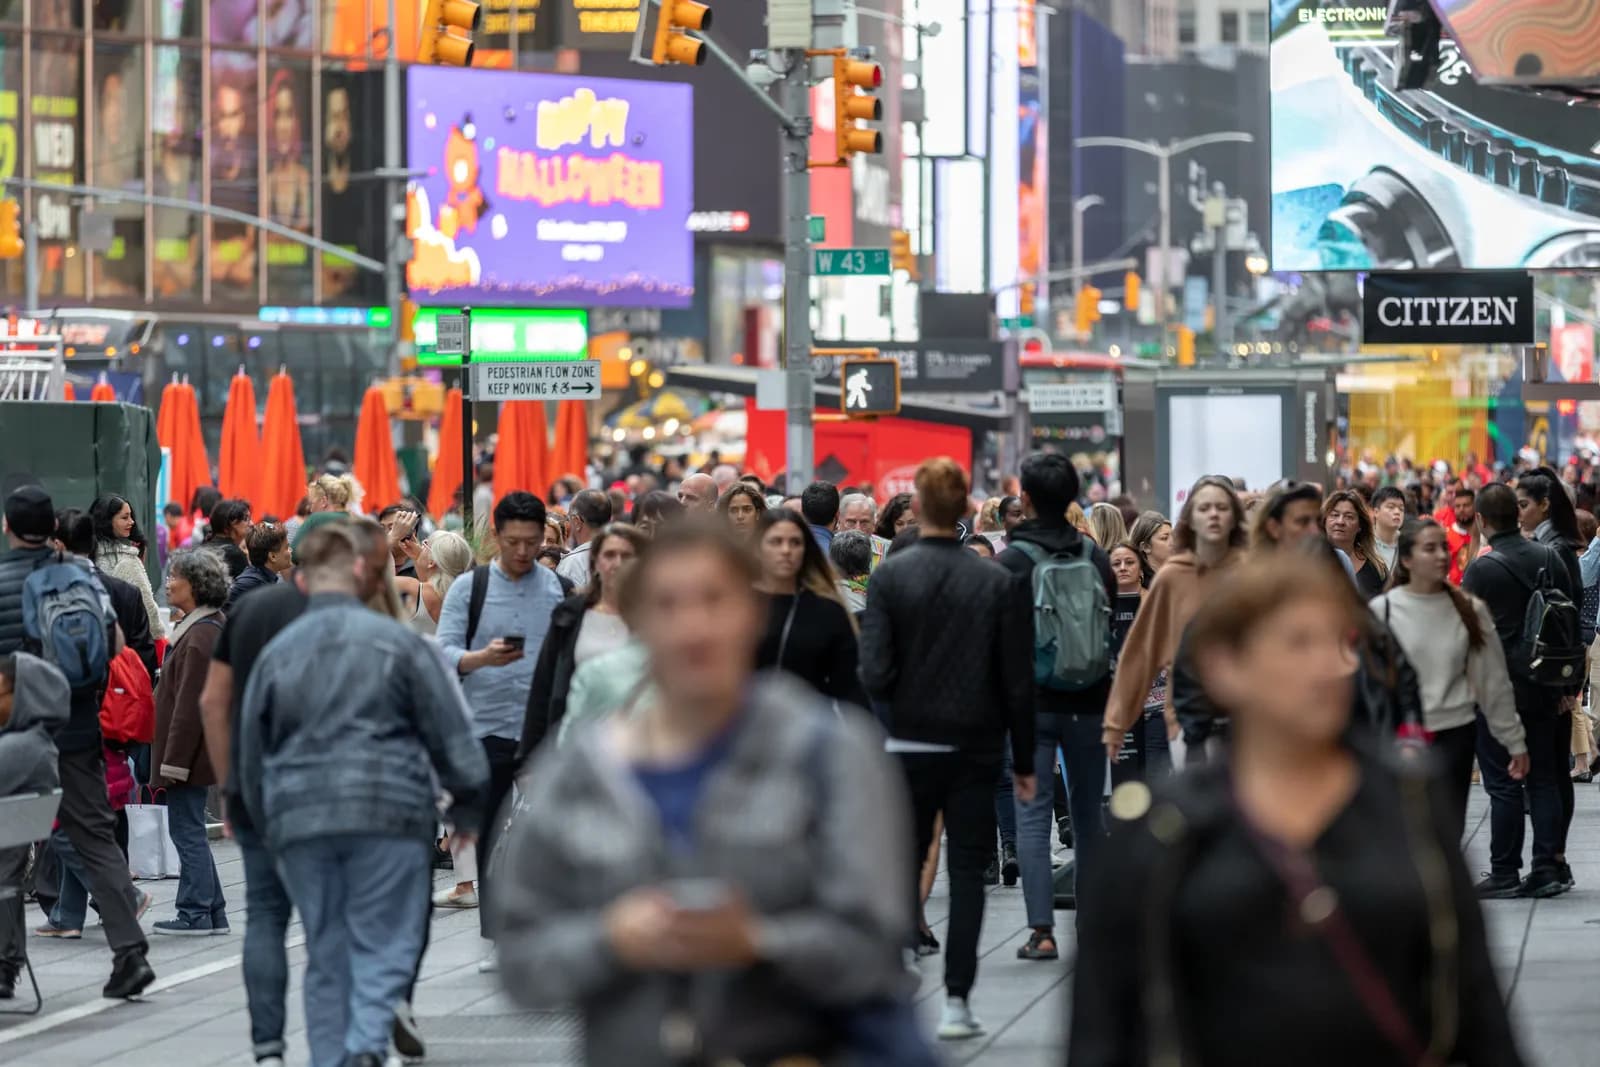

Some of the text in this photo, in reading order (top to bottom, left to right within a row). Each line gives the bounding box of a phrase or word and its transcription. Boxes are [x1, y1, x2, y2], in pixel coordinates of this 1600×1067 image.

[818, 252, 833, 272] W
[840, 251, 865, 273] 43
[1377, 296, 1518, 327] CITIZEN
[487, 366, 595, 379] PEDESTRIAN FLOW ZONE
[487, 383, 547, 395] KEEP MOVING
